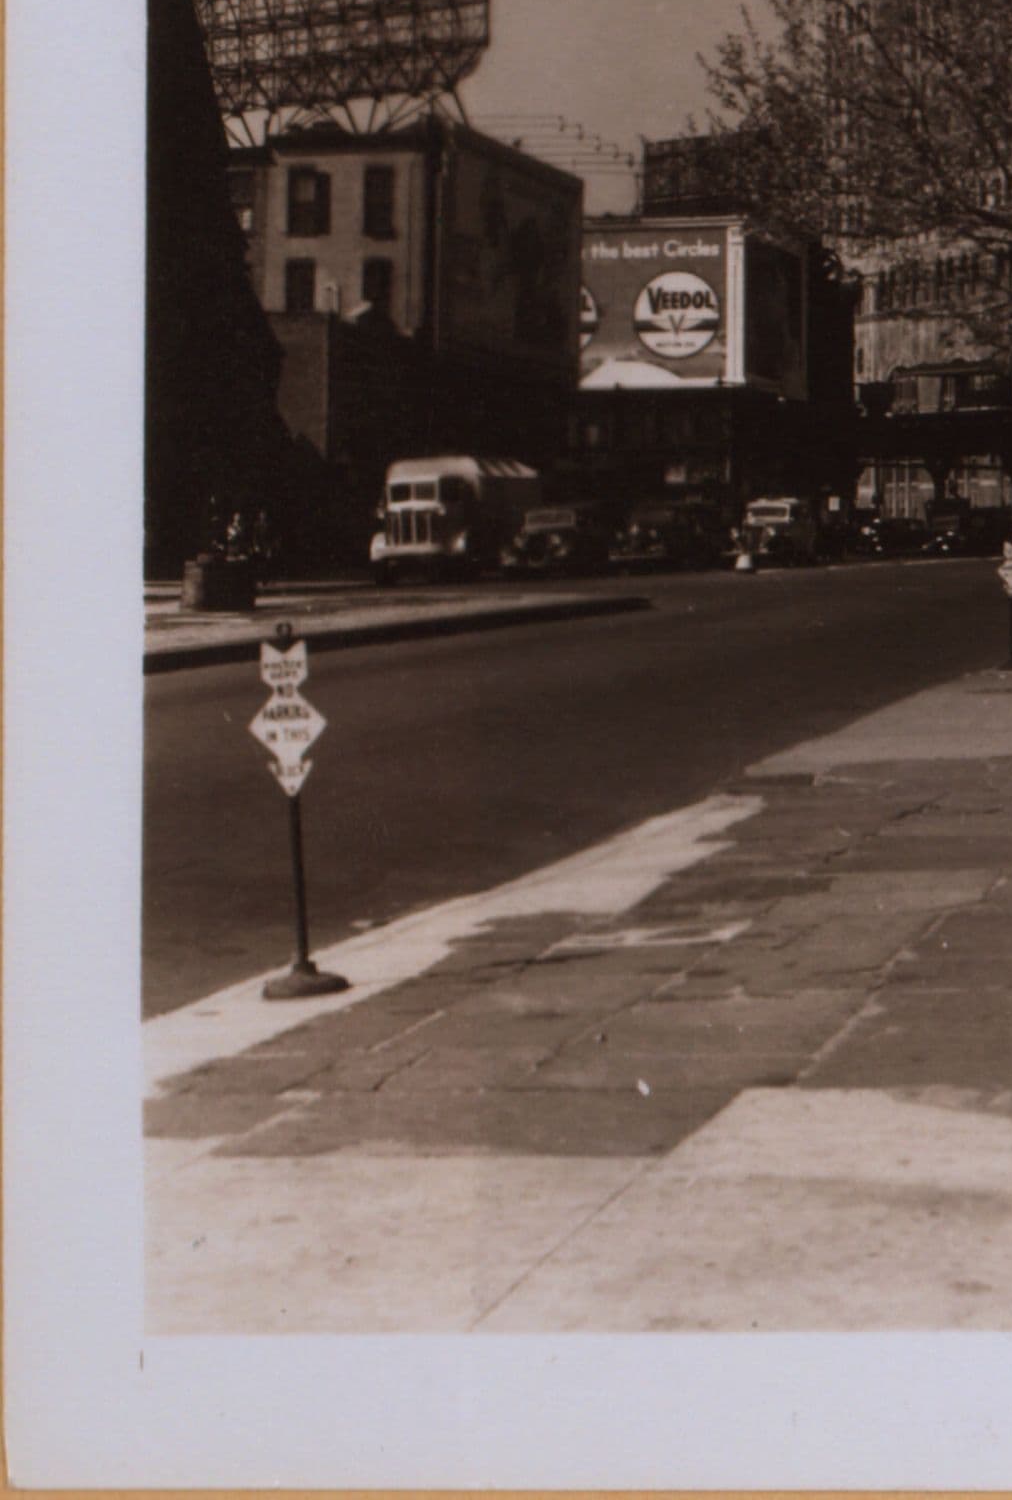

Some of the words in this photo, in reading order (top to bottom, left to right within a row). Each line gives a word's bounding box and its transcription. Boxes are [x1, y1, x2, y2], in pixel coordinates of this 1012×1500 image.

[591, 240, 619, 259] the
[622, 240, 659, 258] best
[663, 238, 720, 257] Circles
[647, 286, 715, 315] VEEDOL
[276, 684, 294, 698] NO
[263, 705, 310, 721] PARKING
